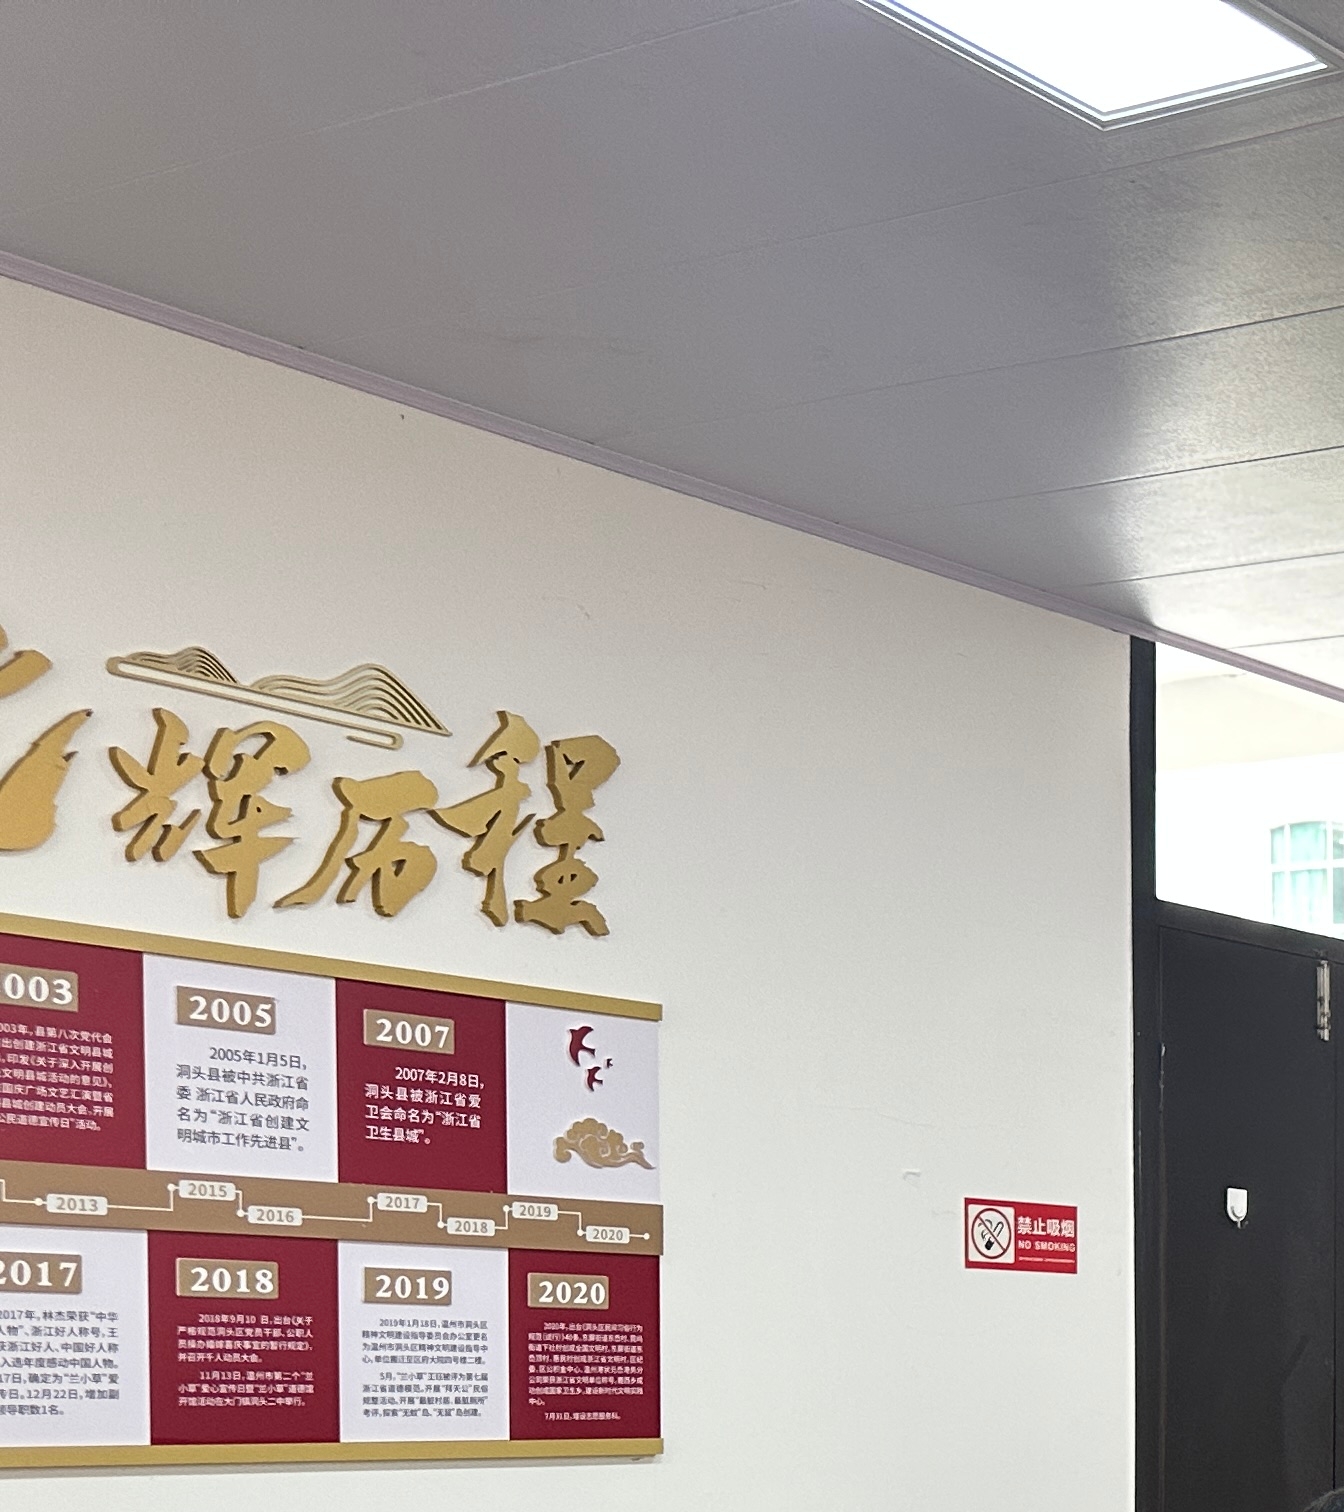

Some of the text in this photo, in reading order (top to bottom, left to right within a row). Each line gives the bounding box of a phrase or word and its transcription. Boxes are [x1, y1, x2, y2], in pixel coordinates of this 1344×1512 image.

[0, 972, 73, 1005] 003
[188, 996, 273, 1028] 2005
[375, 1018, 450, 1049] 2007
[176, 1063, 309, 1091] 洞头县被中共浙江省
[365, 1084, 481, 1109] 洞头县被浙江省爱
[187, 1183, 228, 1199] 2015
[55, 1196, 99, 1212] 2013
[385, 1196, 420, 1210] 2017
[519, 1205, 551, 1218] 2019
[256, 1208, 295, 1223] 2016
[454, 1220, 489, 1234] 2018
[592, 1228, 624, 1241] 2020
[1017, 1216, 1075, 1238] 禁止吸烟
[1018, 1240, 1076, 1253] NO SMOKING
[190, 1267, 274, 1294] 2018
[375, 1274, 450, 1299] 2019
[538, 1280, 606, 1305] 2020
